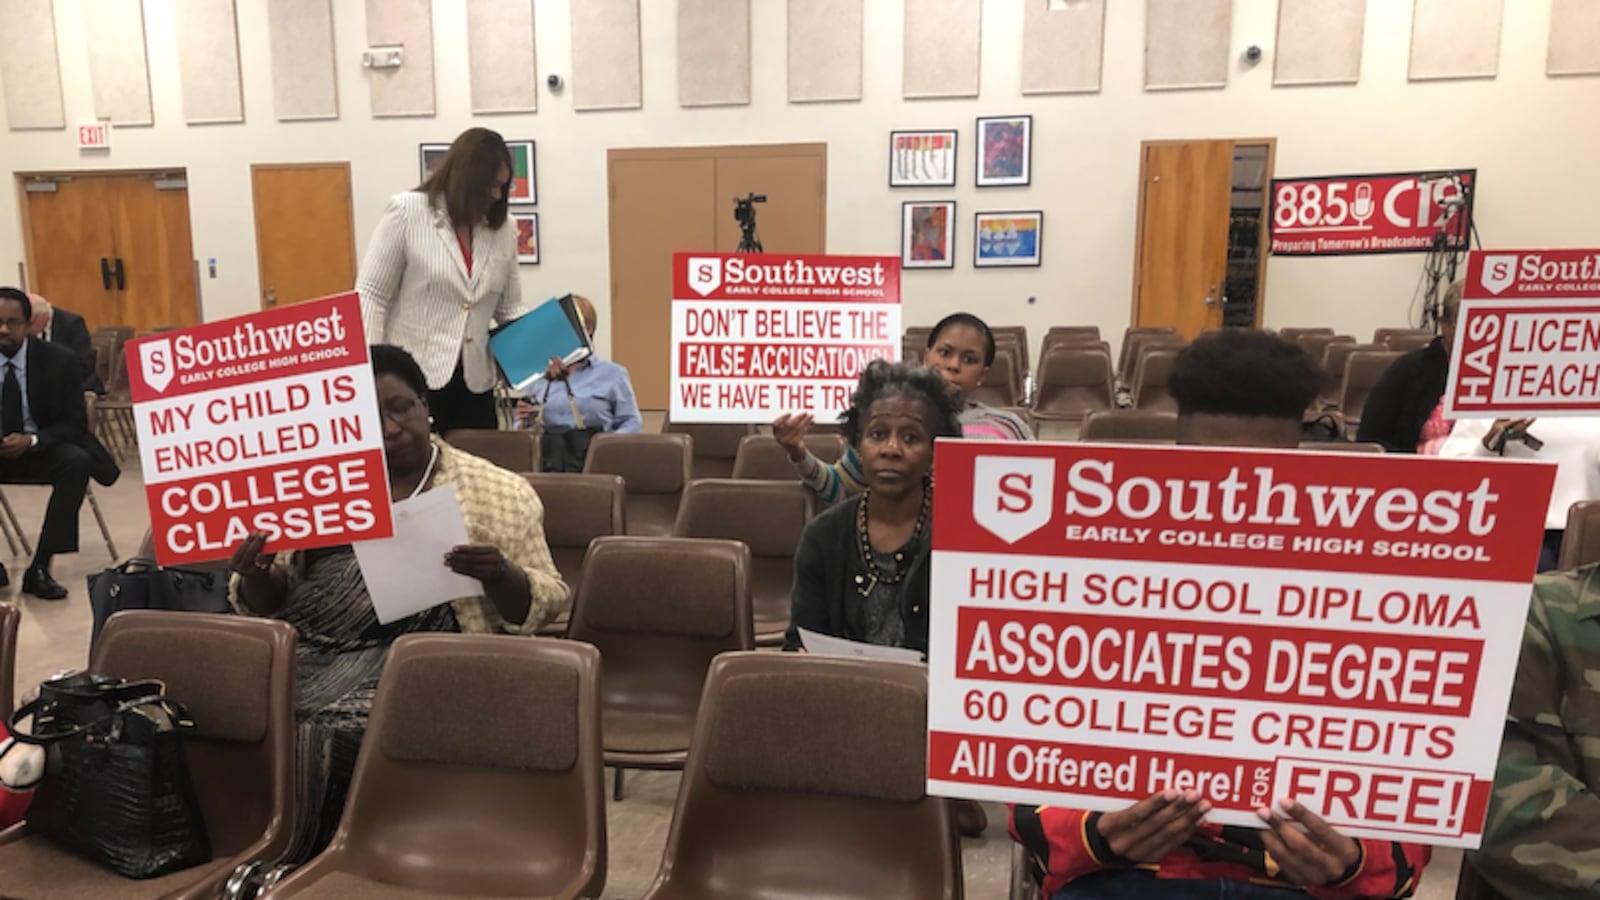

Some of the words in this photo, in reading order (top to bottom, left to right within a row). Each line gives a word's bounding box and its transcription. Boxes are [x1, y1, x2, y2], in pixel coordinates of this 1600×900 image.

[80, 126, 104, 145] EXIT
[1274, 182, 1348, 227] 88.5
[1272, 238, 1316, 252] Preparing
[1318, 237, 1370, 249] Tomorrow's
[698, 264, 713, 282] S
[725, 258, 885, 286] Southwest
[1491, 262, 1508, 281] S
[1518, 282, 1553, 292] EARLY
[725, 286, 759, 295] EARLY
[762, 287, 809, 296] COLLEGE
[812, 287, 840, 296] HIGH
[842, 287, 885, 297] SCHOOL
[175, 306, 346, 371] Southwest
[686, 308, 748, 337] DON'T
[755, 309, 841, 338] BELIEVE
[847, 311, 888, 339] THE
[1508, 319, 1600, 353] LICEN
[150, 349, 166, 375] S
[180, 371, 215, 385] EARLY
[216, 360, 267, 379] COLLEGE
[269, 354, 298, 369] HIGH
[301, 346, 349, 363] SCHOOL
[686, 345, 746, 375] FALSE
[1458, 314, 1501, 405] HAS
[680, 384, 711, 408] WE
[718, 384, 770, 409] HAVE
[777, 385, 814, 409] THE
[1503, 364, 1600, 397] TEACH
[150, 403, 195, 436] MY
[206, 384, 310, 425] CHILD
[322, 375, 356, 405] IS
[155, 423, 320, 473] ENROLLED
[330, 415, 363, 445] IN
[161, 459, 370, 518] COLLEGE
[997, 473, 1033, 514] S
[1065, 459, 1499, 536] Southwest
[166, 499, 376, 554] CLASSES
[1065, 525, 1152, 544] EARLY
[1159, 530, 1284, 551] COLLEGE
[1292, 535, 1365, 555] HIGH
[1372, 540, 1491, 562] SCHOOL
[969, 567, 1068, 603] HIGH
[1083, 573, 1261, 615] SCHOOL
[1277, 584, 1481, 630] DIPLOMA
[965, 619, 1252, 691] ASSOCIATES
[1264, 638, 1469, 707] DEGREE
[963, 689, 1008, 722] 60
[1023, 693, 1236, 741] COLLEGE
[1251, 711, 1456, 760] CREDITS
[950, 739, 997, 778] All
[1006, 743, 1137, 792] Offered
[1147, 757, 1244, 802] Here!
[1250, 766, 1272, 808] FOR
[1288, 766, 1464, 828] FREE!
